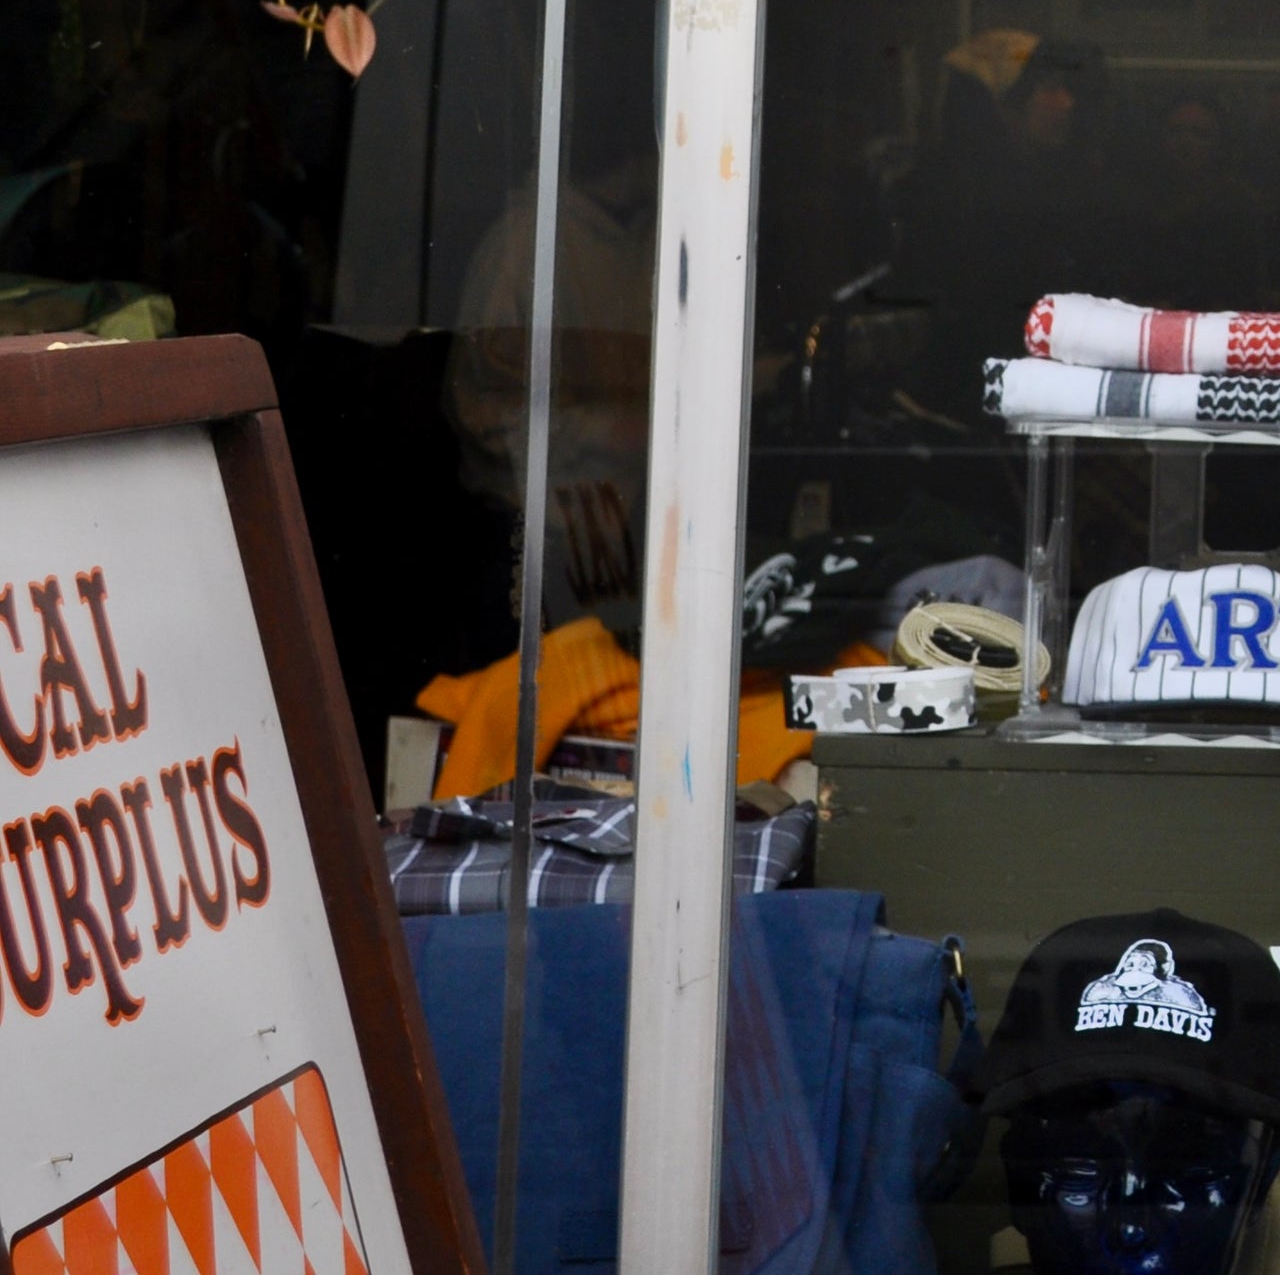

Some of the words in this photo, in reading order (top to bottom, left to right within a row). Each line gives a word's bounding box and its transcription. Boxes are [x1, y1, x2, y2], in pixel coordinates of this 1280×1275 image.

[0, 733, 271, 1028] URPLUS
[1074, 1003, 1128, 1032] BEN
[1133, 1003, 1214, 1043] DAVIS
